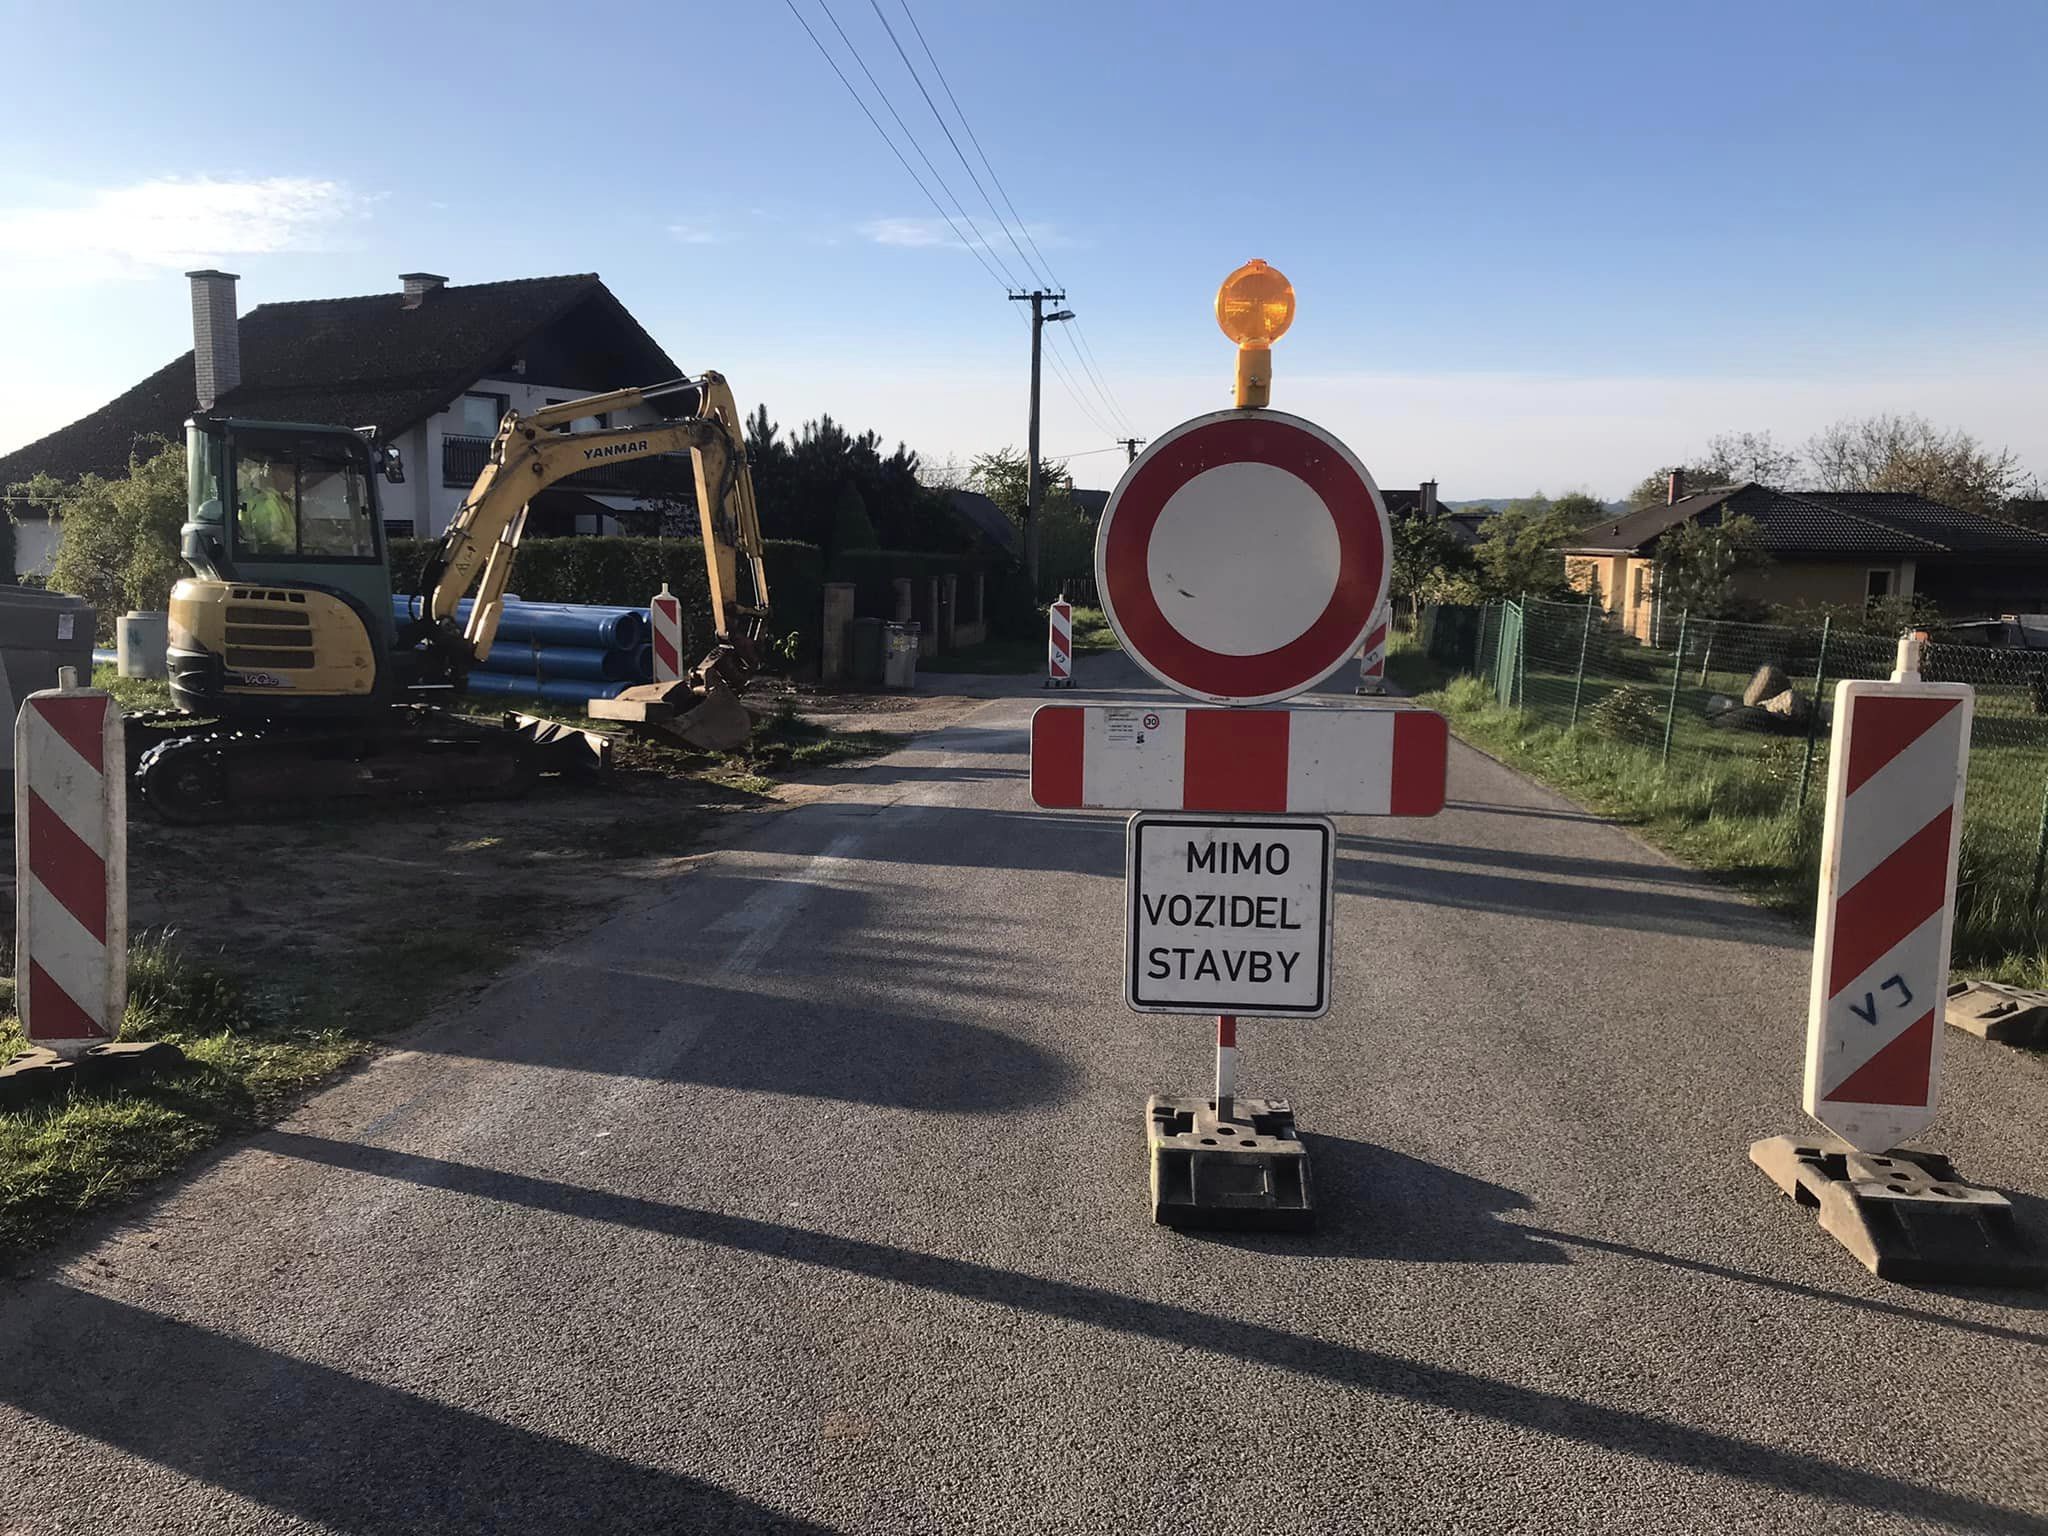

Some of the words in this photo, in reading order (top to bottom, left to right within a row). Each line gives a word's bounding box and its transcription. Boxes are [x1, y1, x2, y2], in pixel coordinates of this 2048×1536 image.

[583, 440, 648, 459] YANMAR
[1146, 718, 1157, 726] 30
[1187, 841, 1290, 875] MIMO
[1142, 894, 1301, 930] VOZIDEL
[1147, 947, 1300, 983] STAVBY
